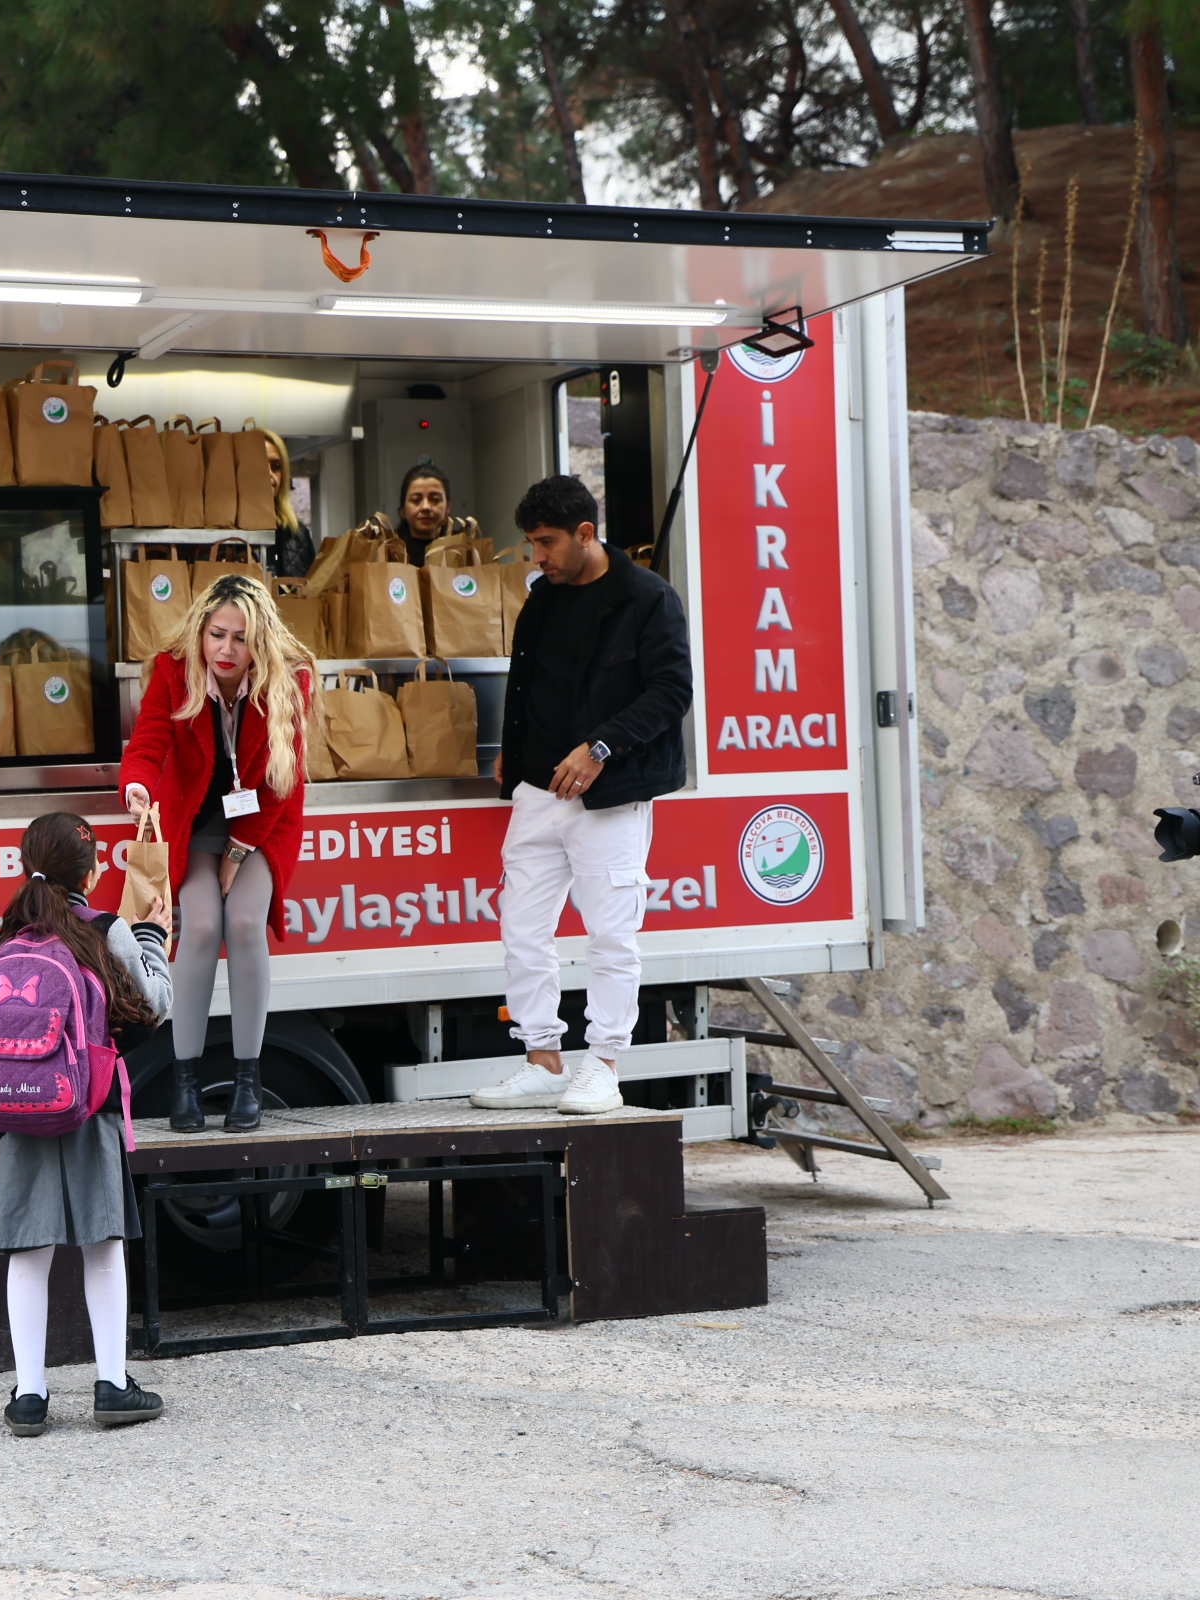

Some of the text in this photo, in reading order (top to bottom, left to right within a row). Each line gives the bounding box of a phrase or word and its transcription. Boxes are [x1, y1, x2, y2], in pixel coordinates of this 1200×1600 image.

[716, 713, 838, 751] ARACI
[299, 816, 452, 862] EDİYESİ
[745, 813, 773, 858] BALÇOVA
[774, 890, 793, 899] 1963
